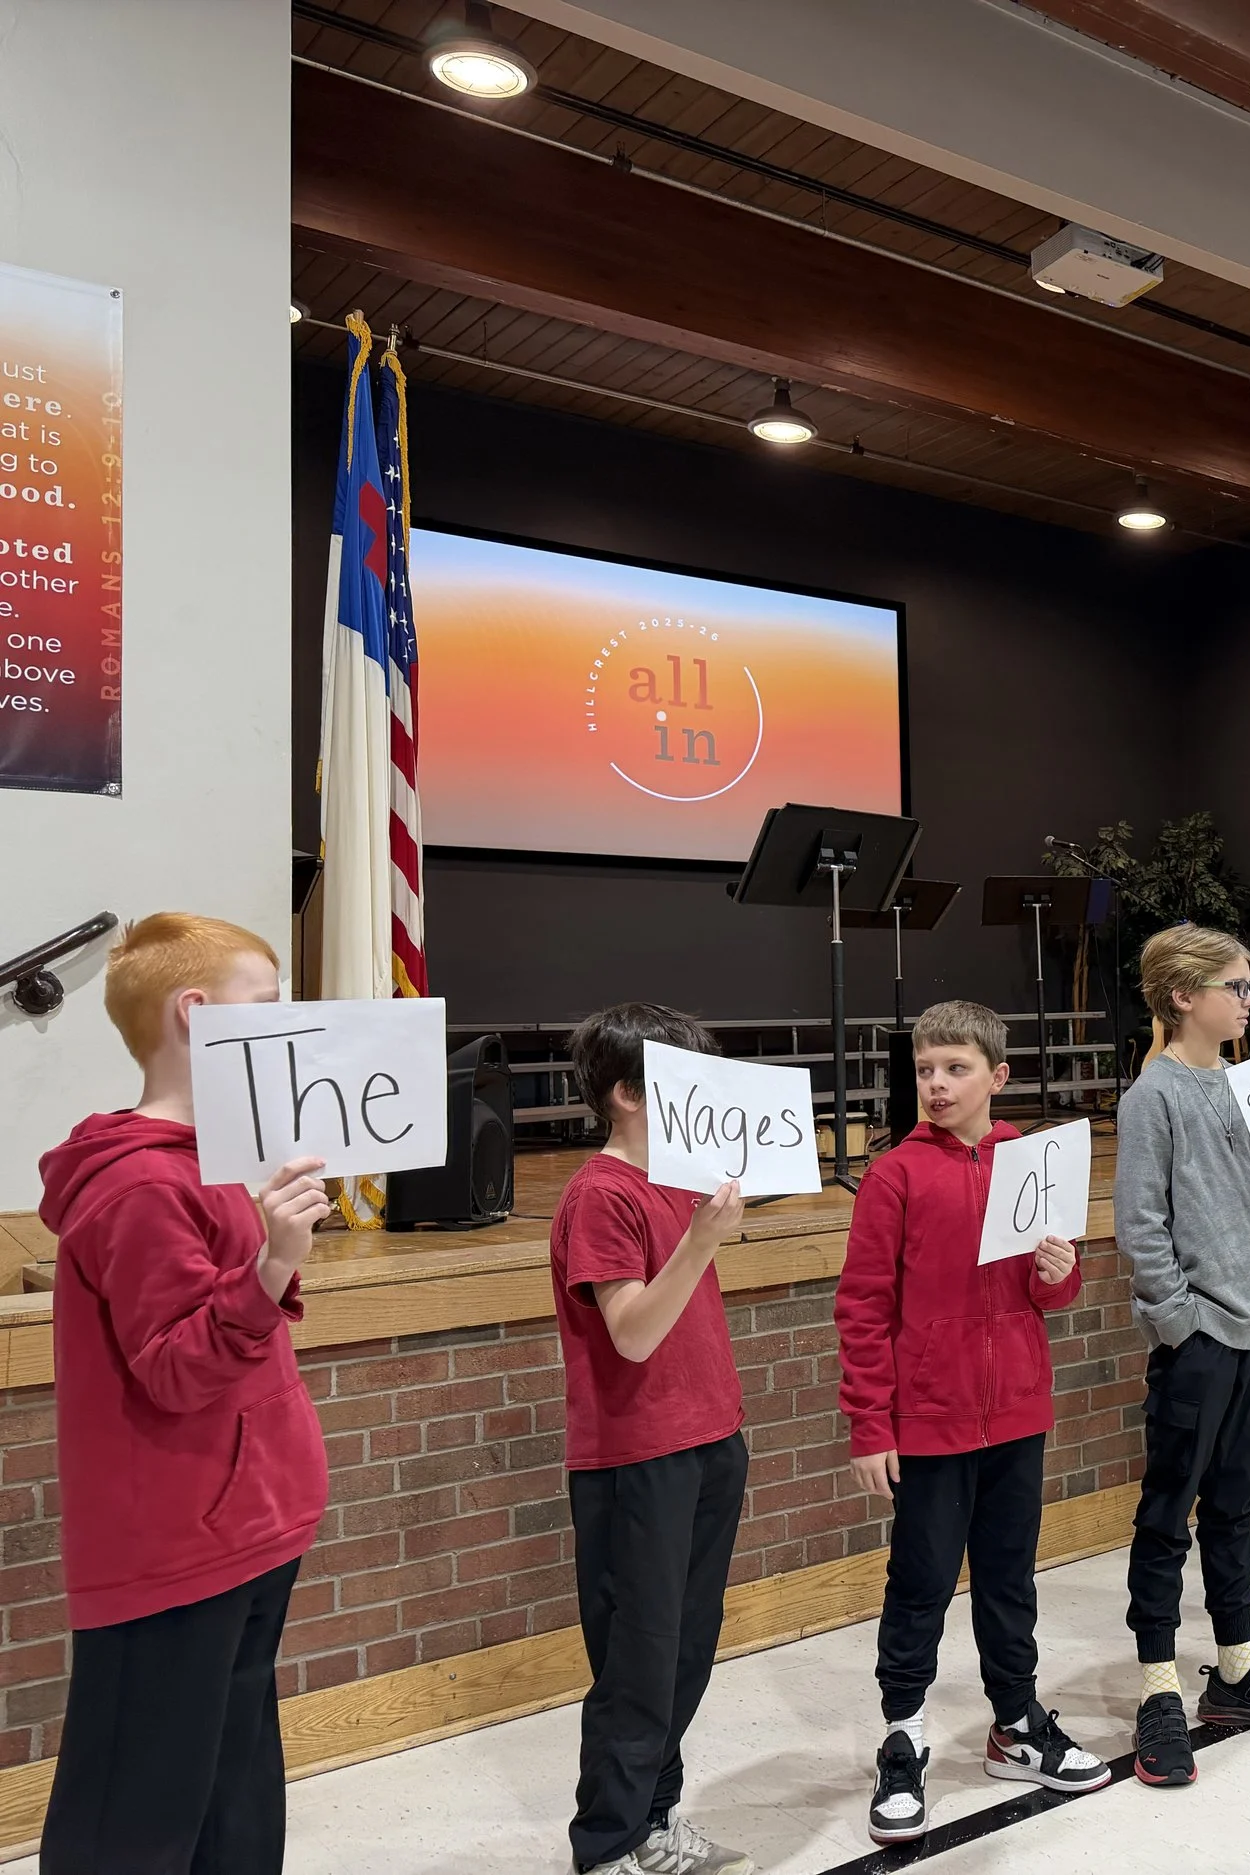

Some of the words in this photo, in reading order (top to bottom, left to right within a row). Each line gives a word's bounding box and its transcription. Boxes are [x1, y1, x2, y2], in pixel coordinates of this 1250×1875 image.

[1, 421, 30, 441] at
[41, 424, 62, 446] is
[3, 391, 72, 419] ere.
[28, 453, 58, 475] to
[7, 633, 63, 653] one
[100, 550, 122, 702] ROMANS
[586, 630, 629, 732] HILLCREST
[638, 616, 720, 642] 2025-26
[628, 654, 714, 711] all
[653, 710, 721, 766] in
[205, 1027, 414, 1163] The
[653, 1081, 804, 1178] Wages
[1013, 1139, 1061, 1233] of
